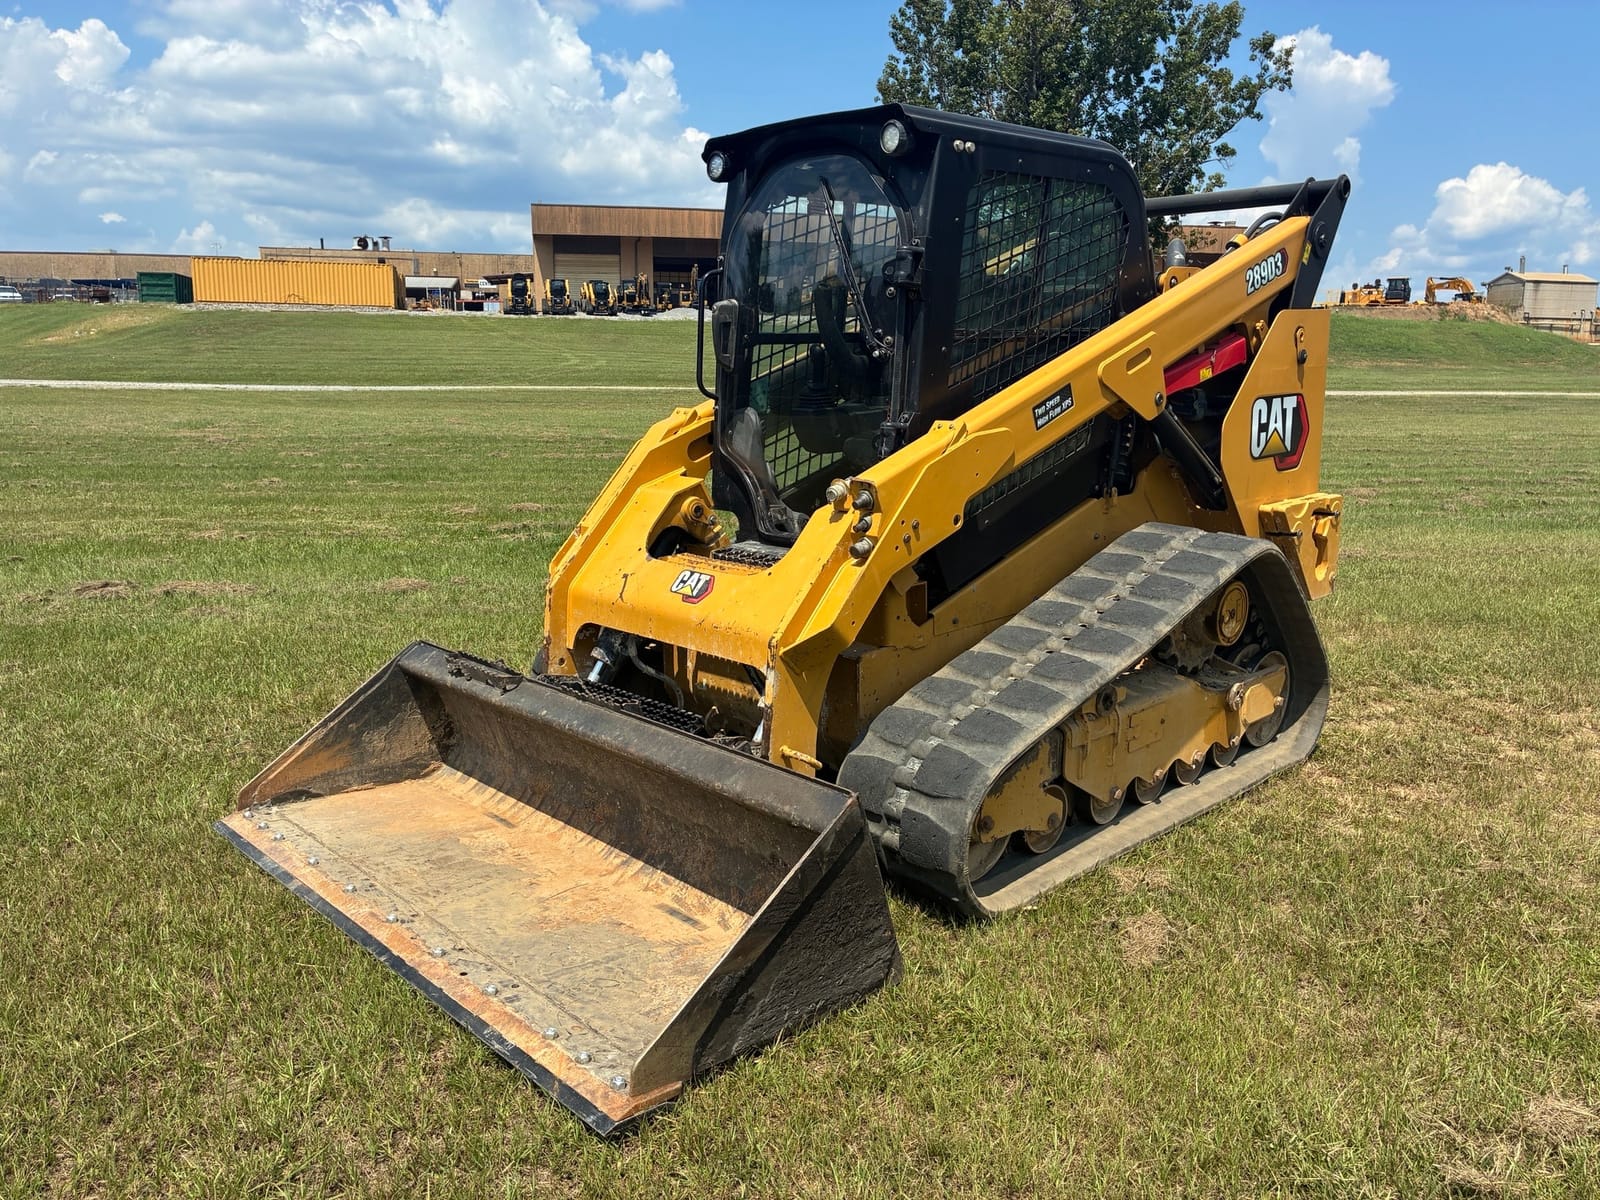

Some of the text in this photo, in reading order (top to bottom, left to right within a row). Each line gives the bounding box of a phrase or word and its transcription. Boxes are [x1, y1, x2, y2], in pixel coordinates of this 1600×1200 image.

[1246, 251, 1283, 295] 289D3
[1250, 395, 1298, 458] CAT
[671, 570, 711, 597] CAT
